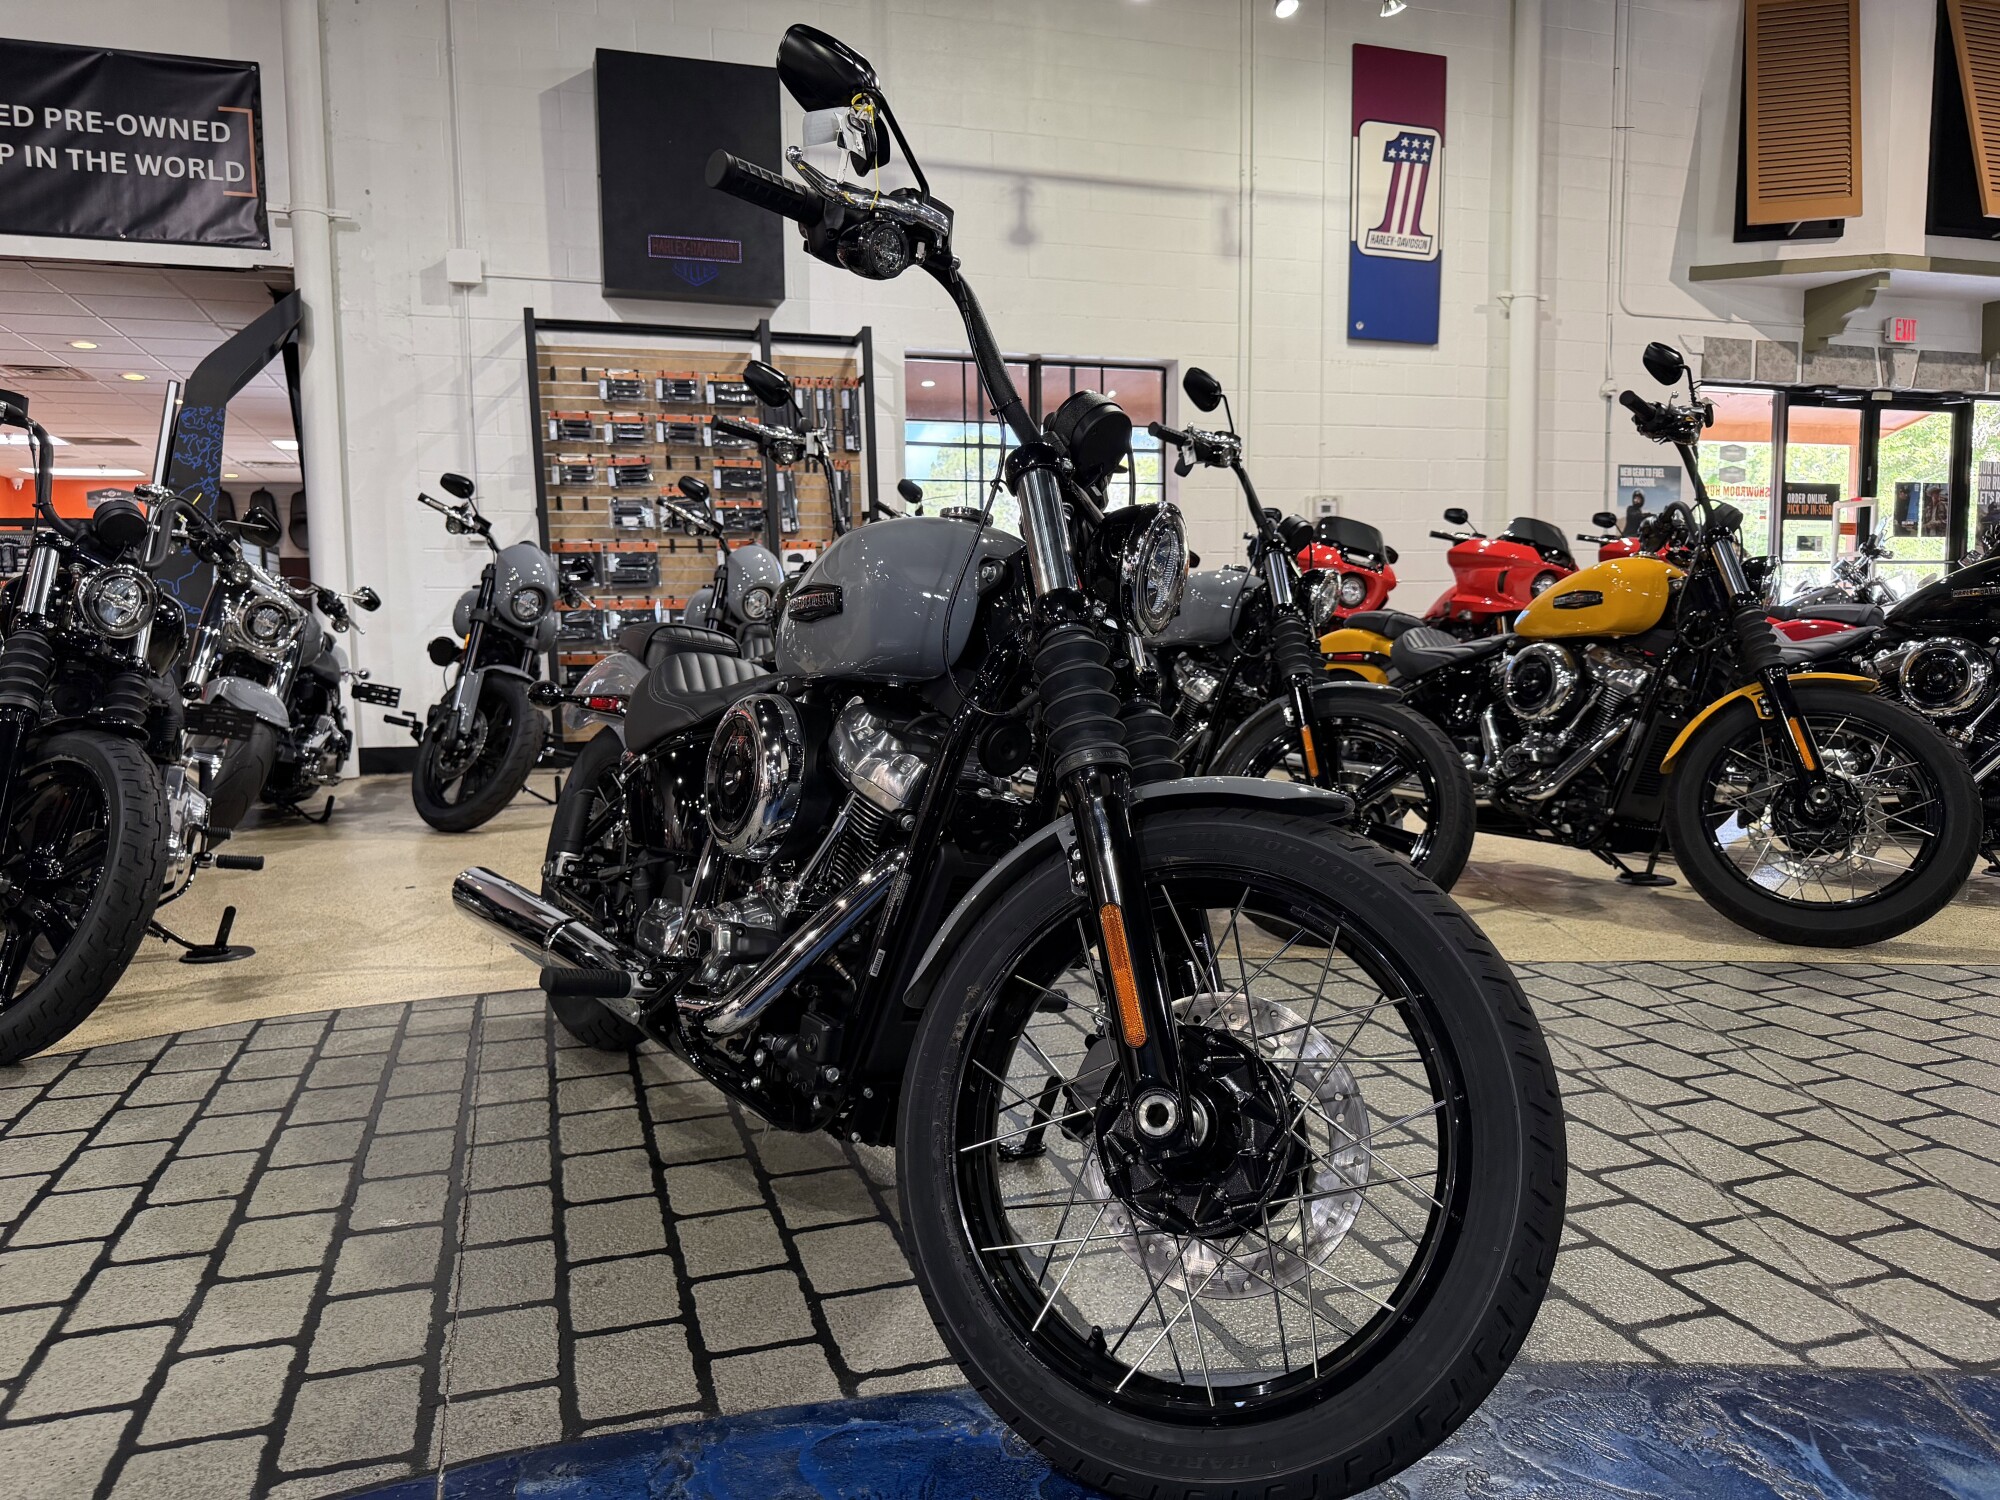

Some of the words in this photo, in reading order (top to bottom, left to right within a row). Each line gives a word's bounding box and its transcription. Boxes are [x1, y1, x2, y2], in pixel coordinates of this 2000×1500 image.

[44, 107, 231, 143] PRE-OWNED
[24, 145, 58, 169] IN
[65, 148, 128, 174] THE
[134, 153, 245, 183] WORLD
[1370, 234, 1429, 250] HARLEY-DAVIDSON
[1895, 318, 1917, 341] EXIT
[1787, 493, 1805, 504] ORDER
[1807, 493, 1829, 504] ONLINE.
[1786, 504, 1800, 515] PICK
[1801, 504, 1809, 515] UP
[1810, 504, 1833, 516] IN-STOR
